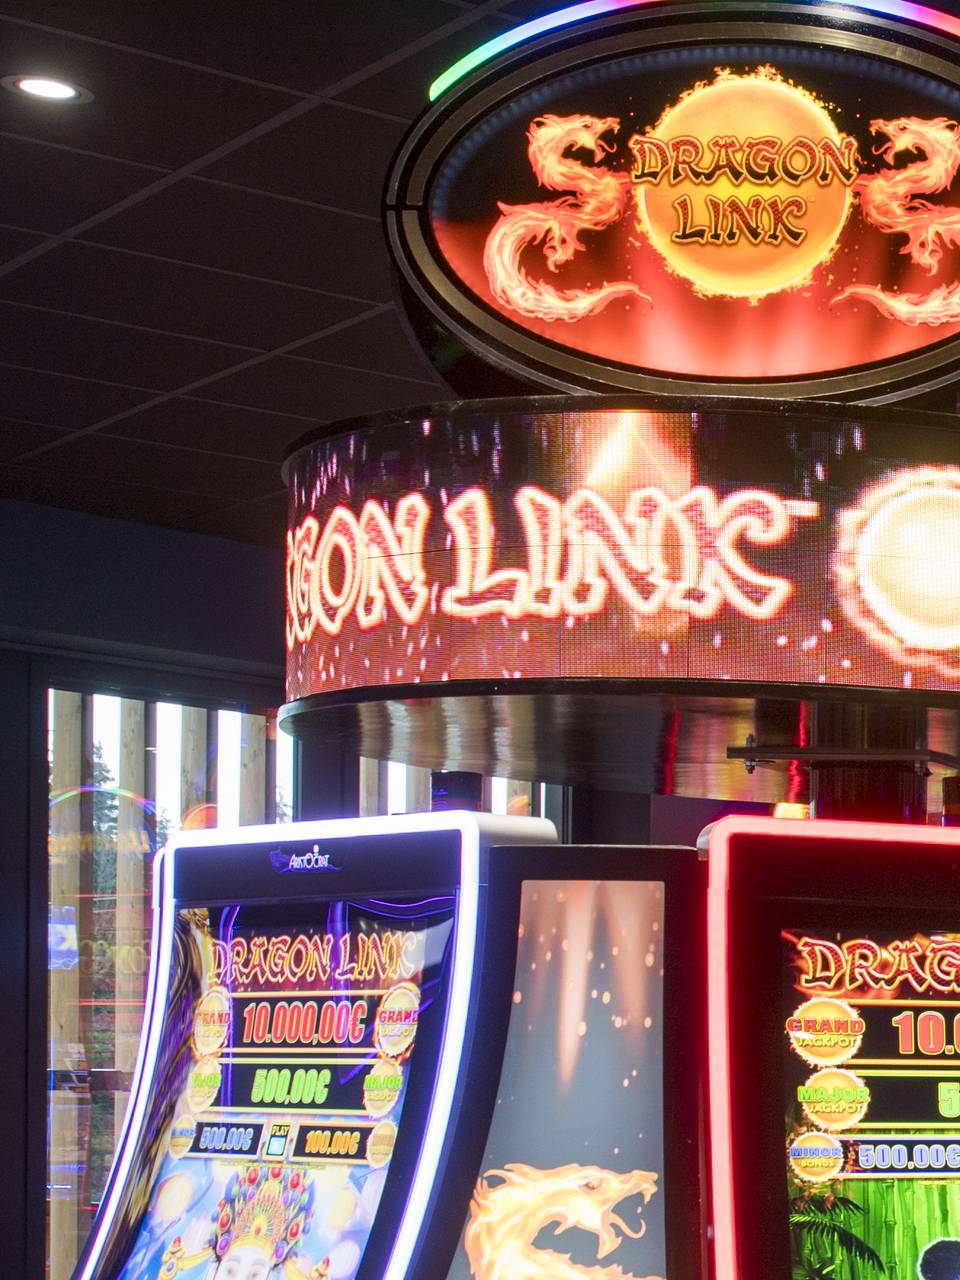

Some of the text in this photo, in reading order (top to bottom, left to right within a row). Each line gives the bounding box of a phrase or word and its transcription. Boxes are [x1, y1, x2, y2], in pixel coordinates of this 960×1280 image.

[627, 134, 859, 187] DRAGON
[672, 194, 808, 246] LINK
[442, 486, 794, 619] LINK
[207, 931, 417, 985] DRAGON LINK
[243, 1000, 368, 1045] 10.000,00€
[379, 1009, 419, 1024] GRAND
[786, 1017, 865, 1035] GRAND
[799, 1036, 857, 1048] JACKPOT
[251, 1069, 331, 1104] 500,00€
[798, 1085, 871, 1102] MAJOR
[808, 1103, 862, 1114] JACKPOT
[272, 1124, 290, 1136] PLAY
